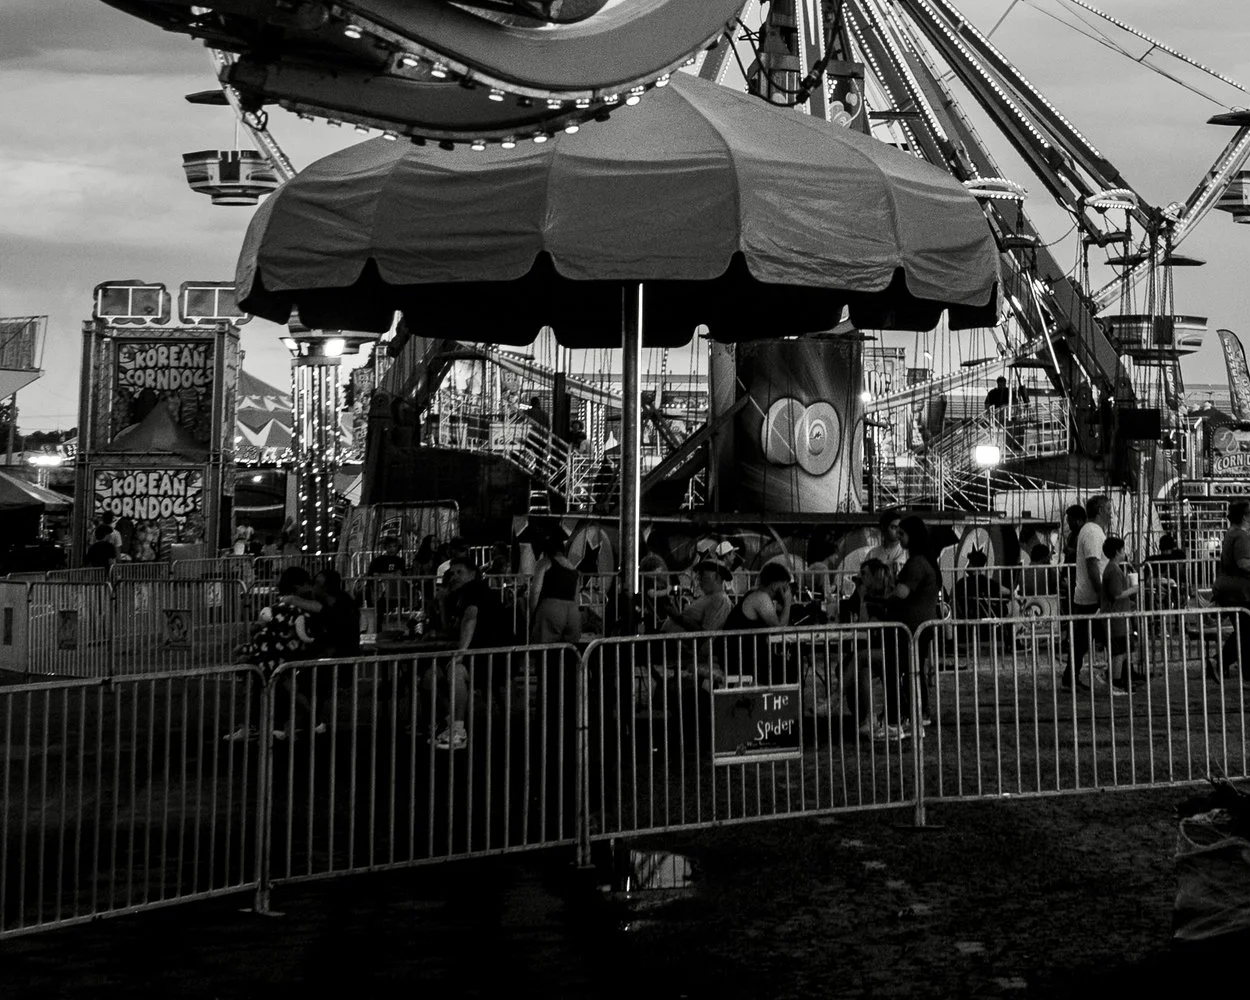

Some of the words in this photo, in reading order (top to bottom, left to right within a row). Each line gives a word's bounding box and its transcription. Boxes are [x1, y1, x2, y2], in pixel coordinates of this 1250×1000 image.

[135, 345, 206, 368] KOREAN
[1222, 338, 1240, 384] FUNNEL
[125, 367, 213, 391] CORNDOGS
[1217, 454, 1243, 471] CORN
[112, 472, 186, 496] KOREAN
[102, 495, 195, 520] CORNDOGS
[754, 718, 795, 741] Spider
